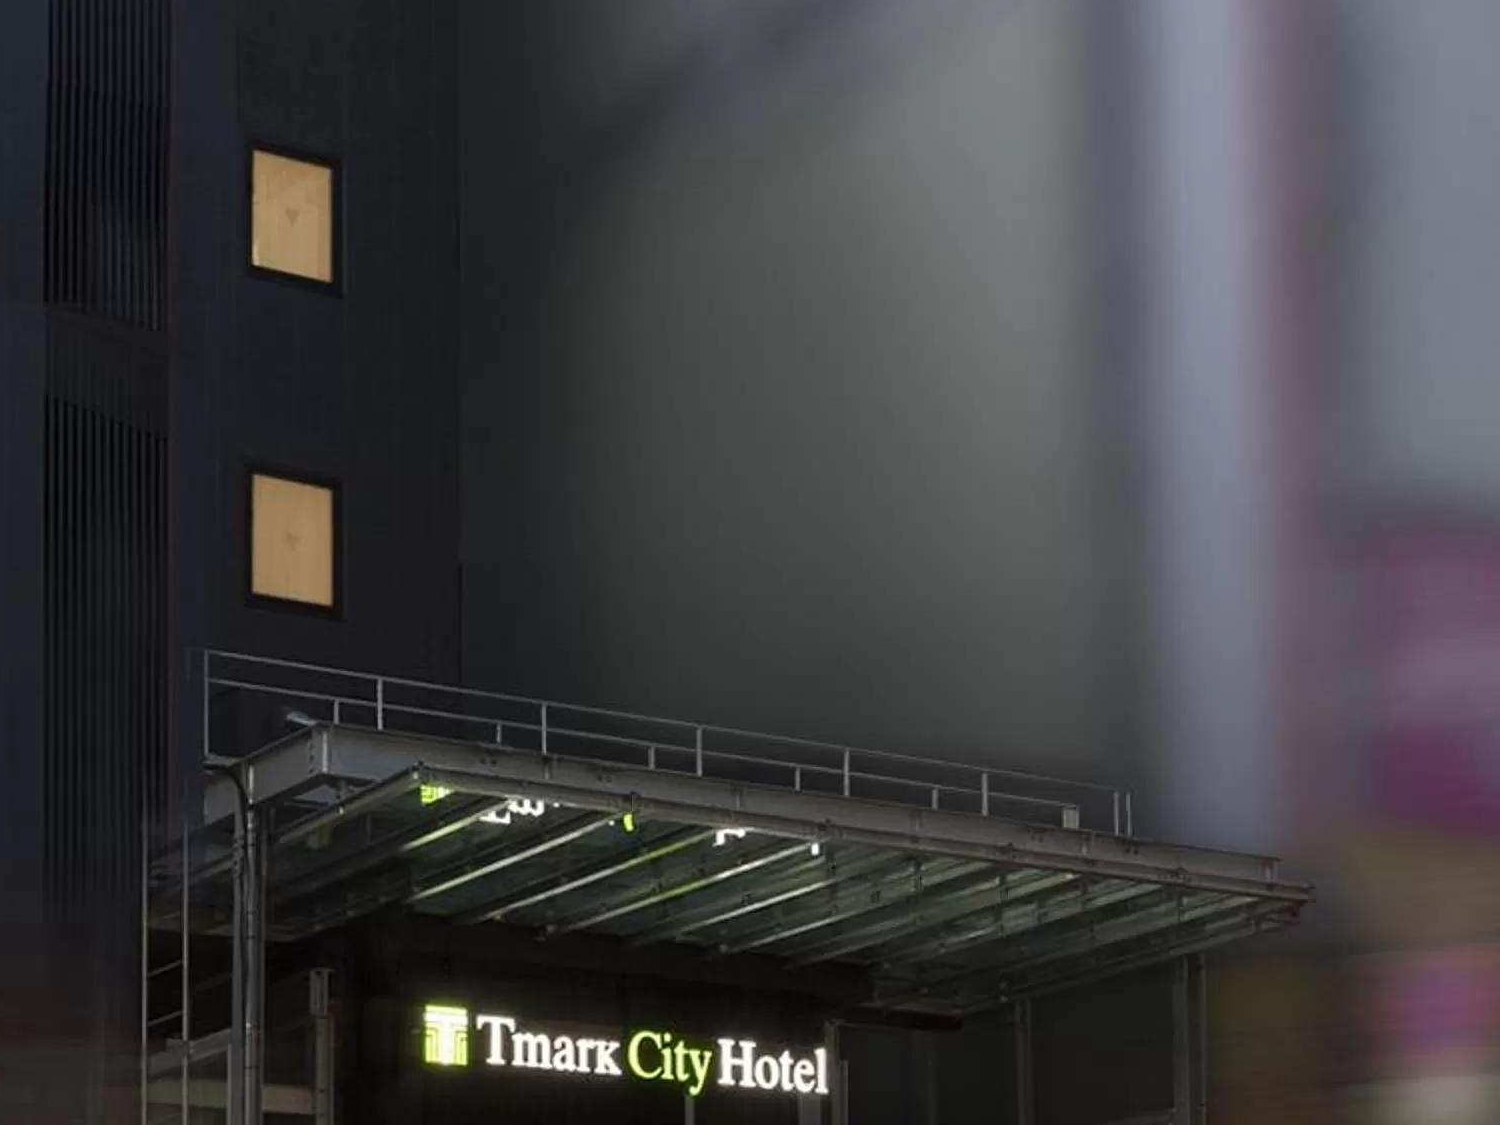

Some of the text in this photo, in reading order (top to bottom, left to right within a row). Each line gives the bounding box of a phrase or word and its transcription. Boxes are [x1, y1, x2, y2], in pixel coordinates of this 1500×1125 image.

[475, 1013, 623, 1076] Tmark
[627, 1030, 713, 1096] City
[716, 1037, 830, 1095] Hotel
